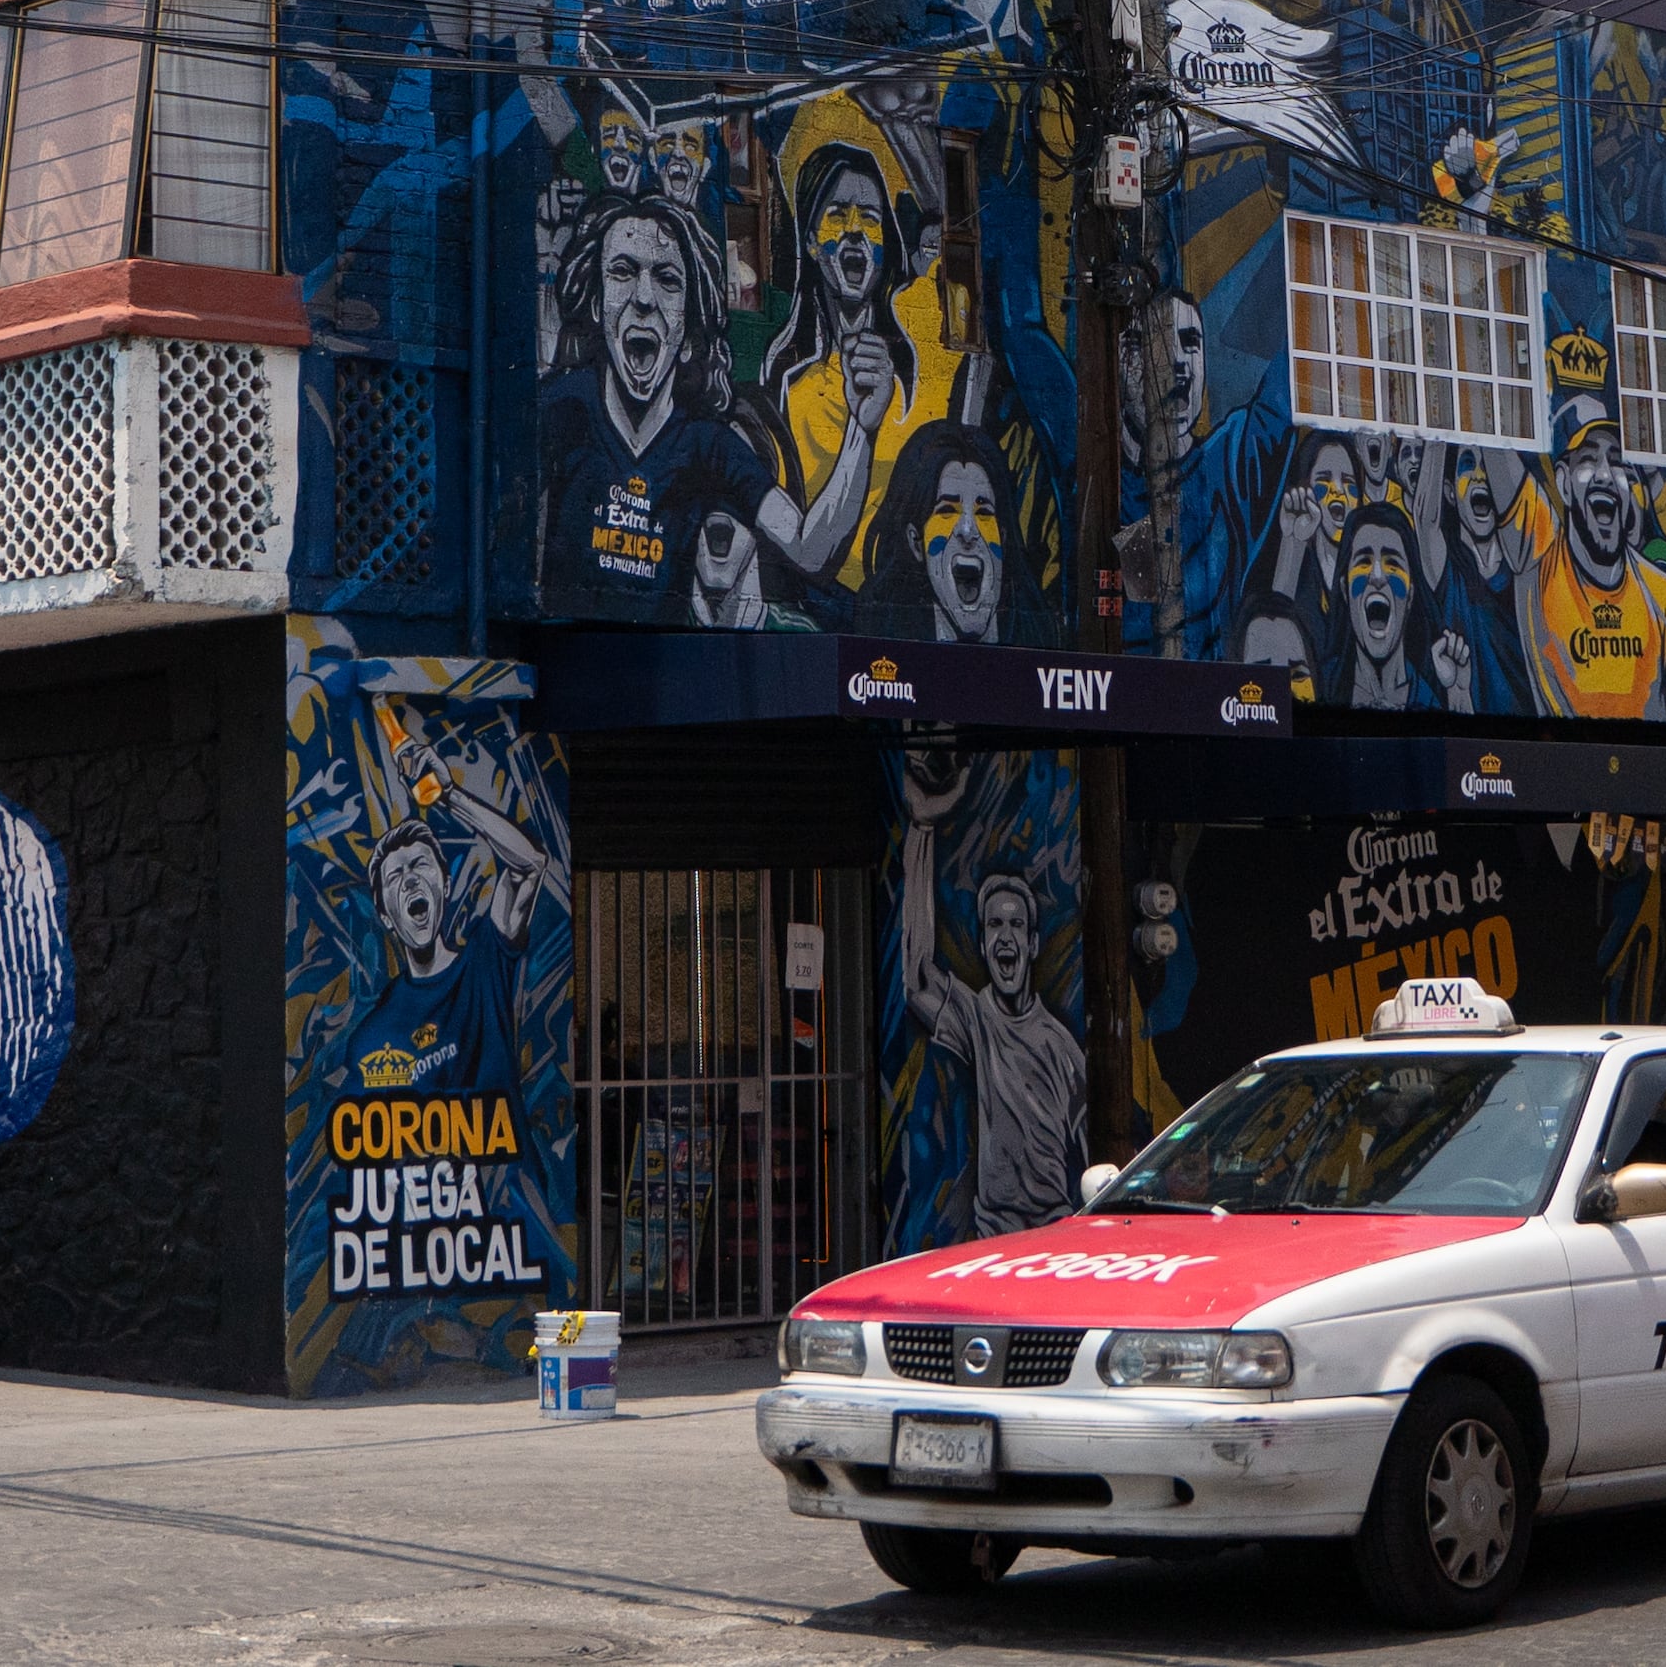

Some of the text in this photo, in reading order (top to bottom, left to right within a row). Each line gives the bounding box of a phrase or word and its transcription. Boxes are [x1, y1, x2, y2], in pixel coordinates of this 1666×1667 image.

[1178, 53, 1275, 100] Corona
[609, 484, 651, 512] Corona
[607, 503, 649, 532] Extra
[592, 525, 664, 563] MÉXICO
[1569, 626, 1644, 666] Corona
[848, 667, 913, 705] Corona
[1036, 668, 1113, 712] YENY
[1220, 692, 1276, 726] Corona
[1461, 771, 1514, 801] Corona
[1347, 826, 1439, 878] Corona
[1308, 859, 1504, 942] el Extra de
[1410, 983, 1462, 1007] TAXI
[1423, 1006, 1457, 1020] LIBRE
[333, 1096, 518, 1162] CORONA
[335, 1163, 484, 1224] JUEGA
[332, 1223, 542, 1293] DE LOCAL
[927, 1252, 1219, 1283] A4366K
